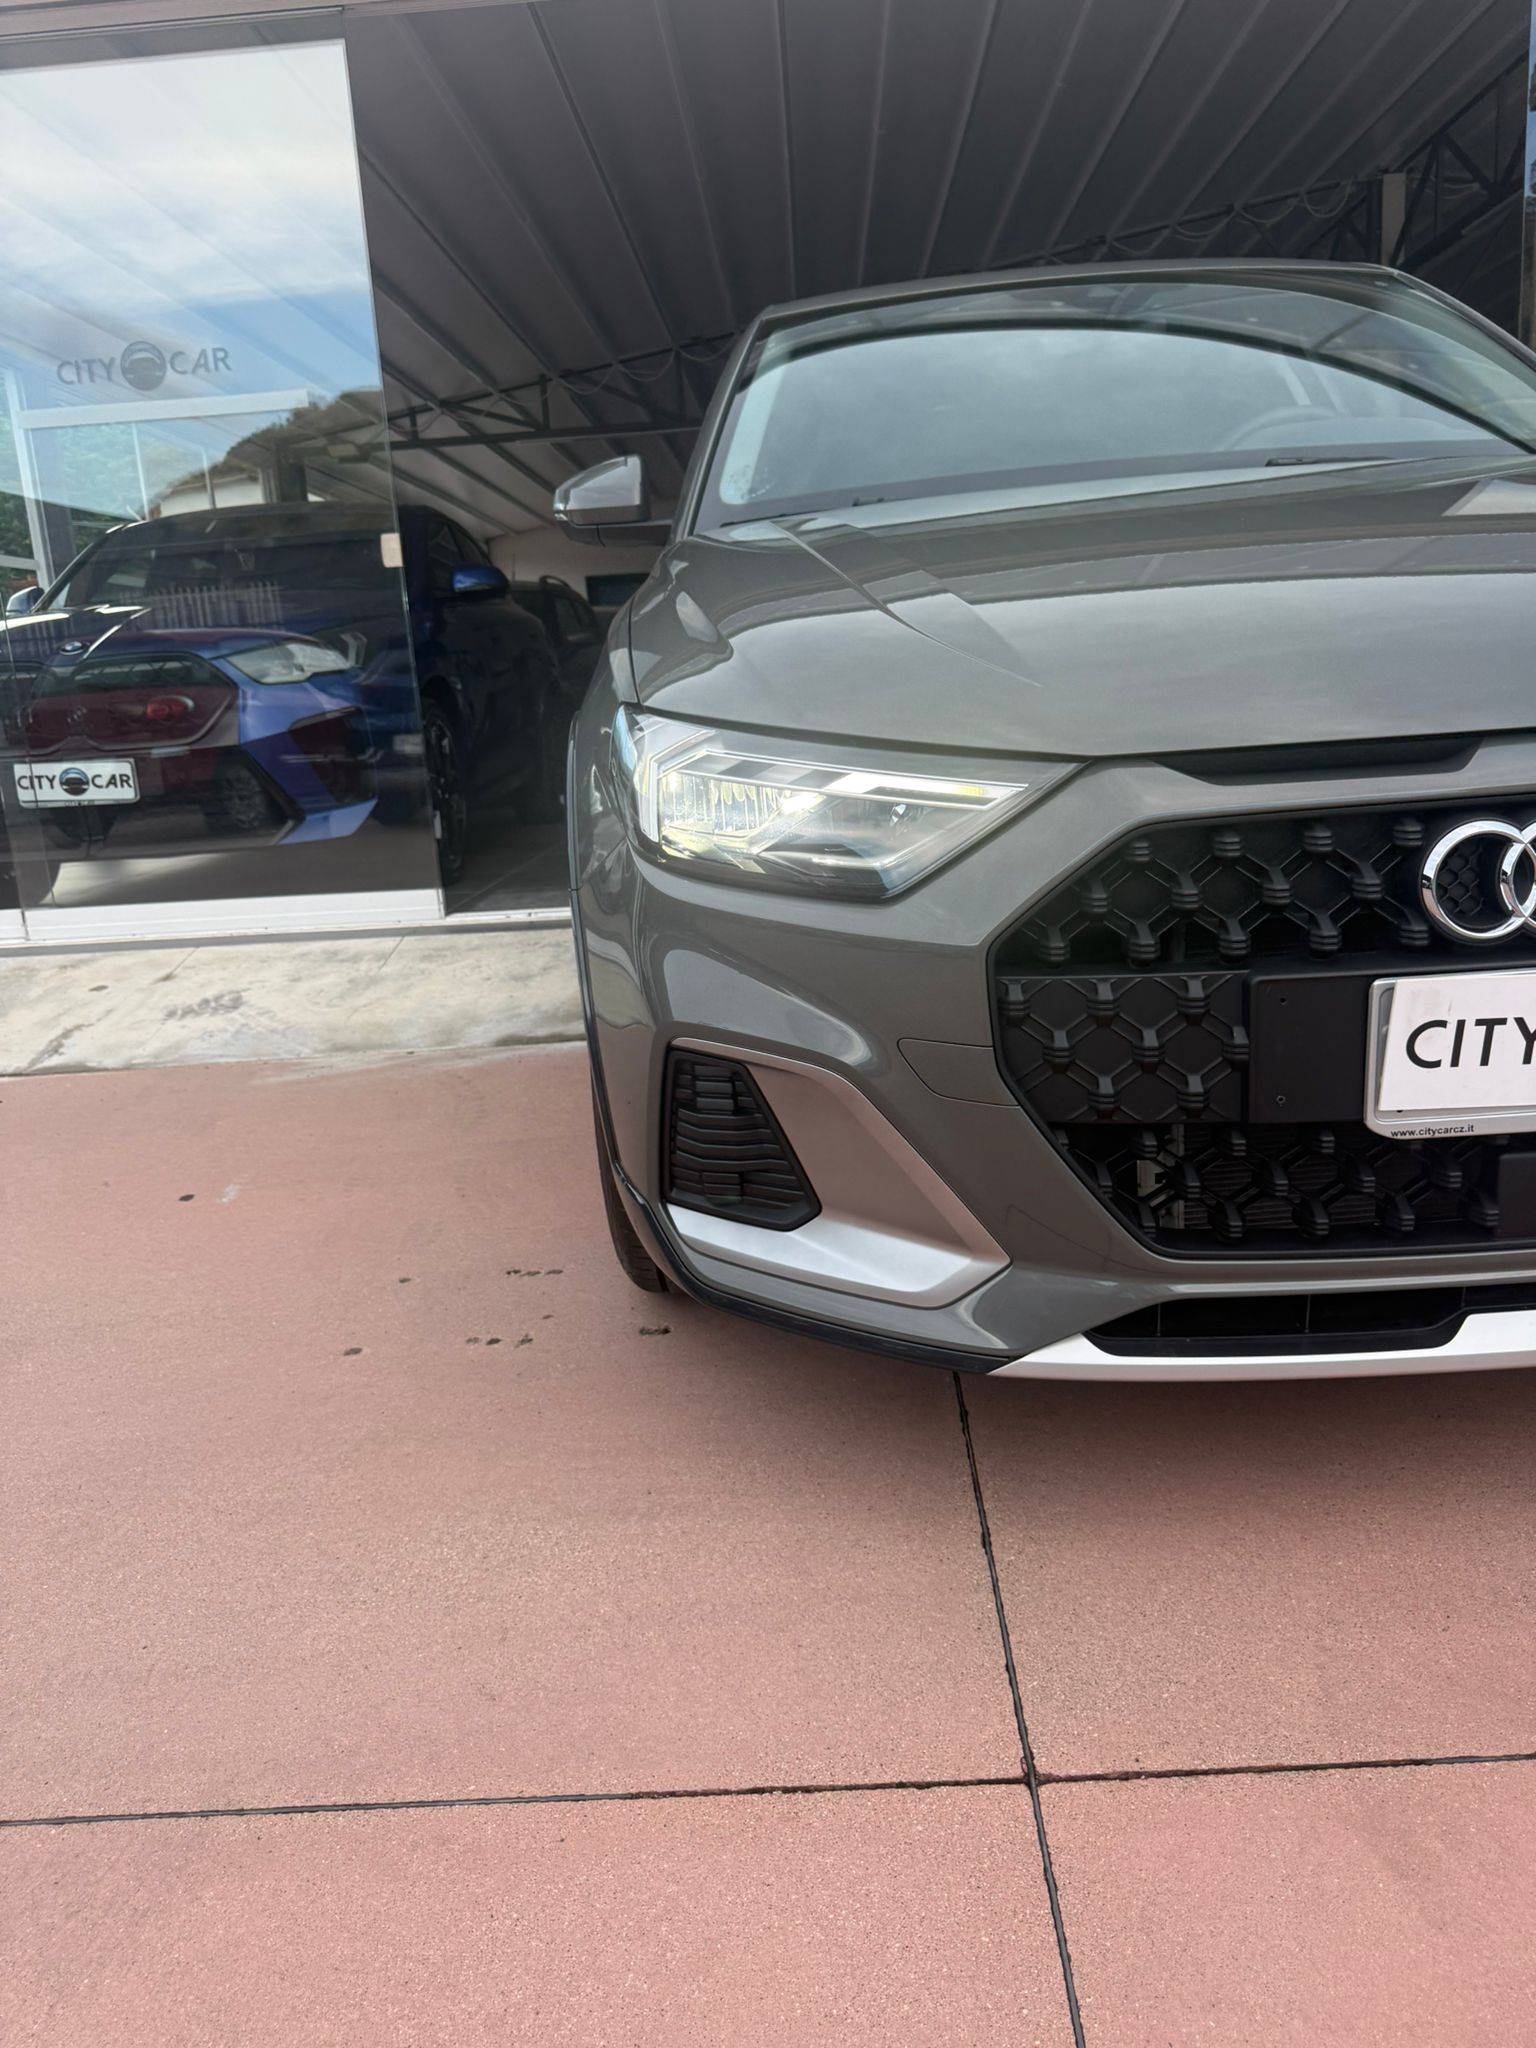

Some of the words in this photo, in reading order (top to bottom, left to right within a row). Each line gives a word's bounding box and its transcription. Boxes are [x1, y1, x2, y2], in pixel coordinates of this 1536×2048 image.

[56, 356, 116, 385] CITY
[169, 346, 233, 375] CAR
[17, 774, 56, 790] CITY
[91, 773, 133, 789] CAR
[1405, 1016, 1536, 1069] CITY
[1390, 1124, 1475, 1137] www.citycarcz.it
